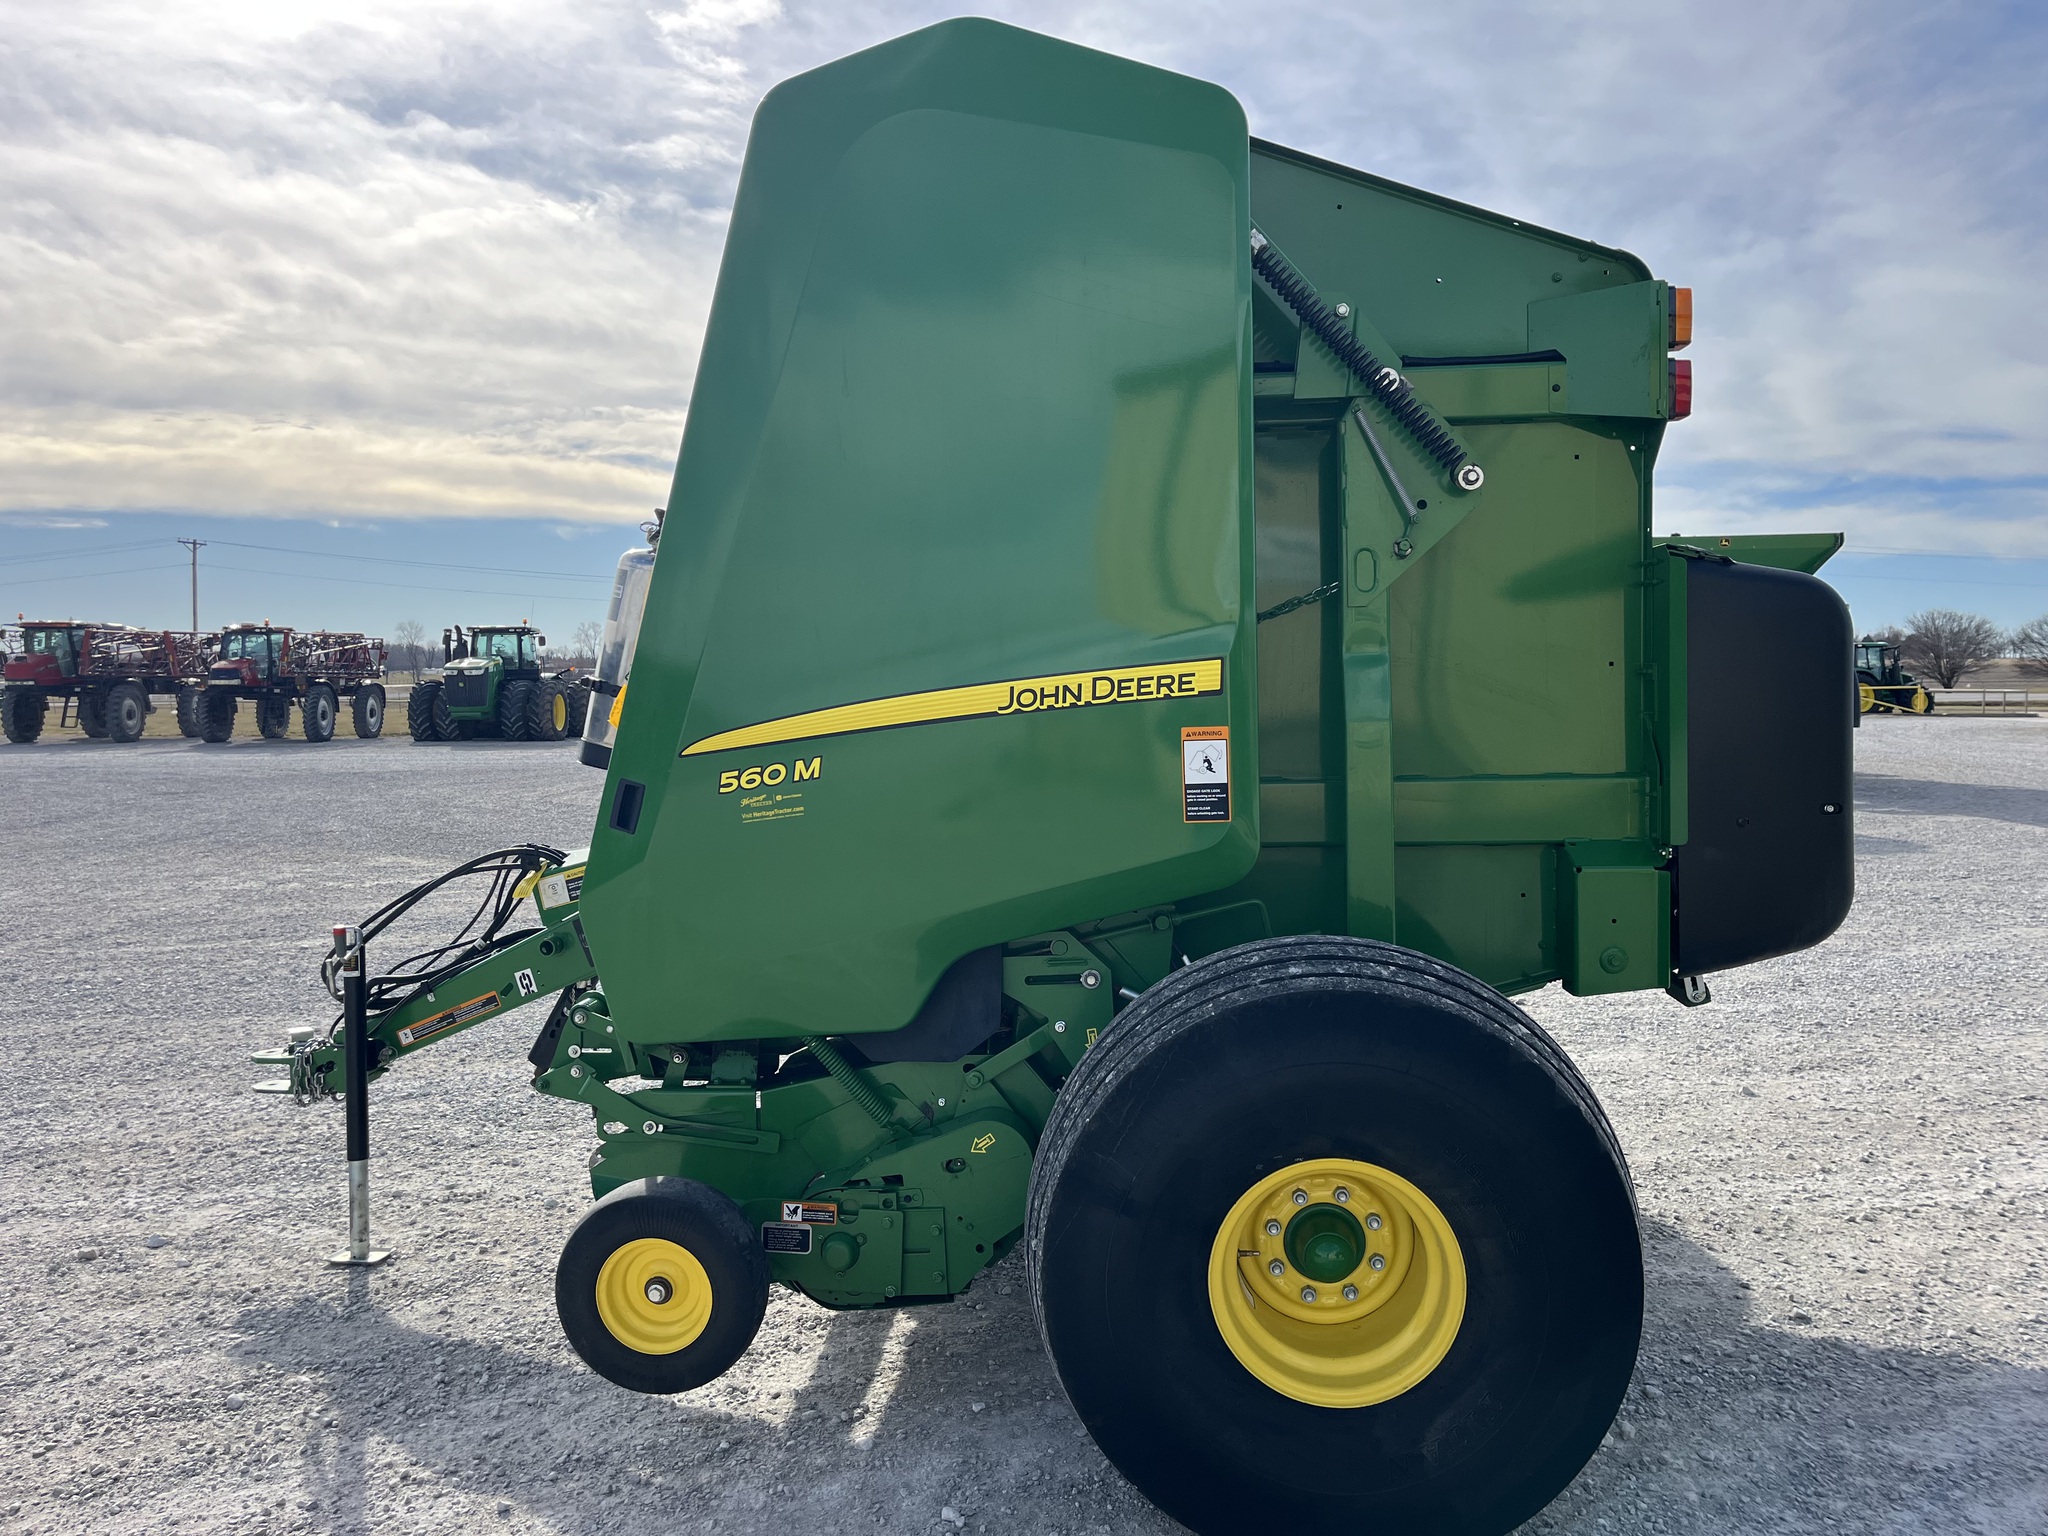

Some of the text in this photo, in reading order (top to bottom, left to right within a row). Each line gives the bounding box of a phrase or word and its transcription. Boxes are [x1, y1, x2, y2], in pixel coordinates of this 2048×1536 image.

[998, 673, 1196, 711] JOHN DEERE
[719, 757, 821, 793] 560 M
[753, 806, 804, 817] HeritageTractor.com
[1388, 1391, 1503, 1481] TITAN
